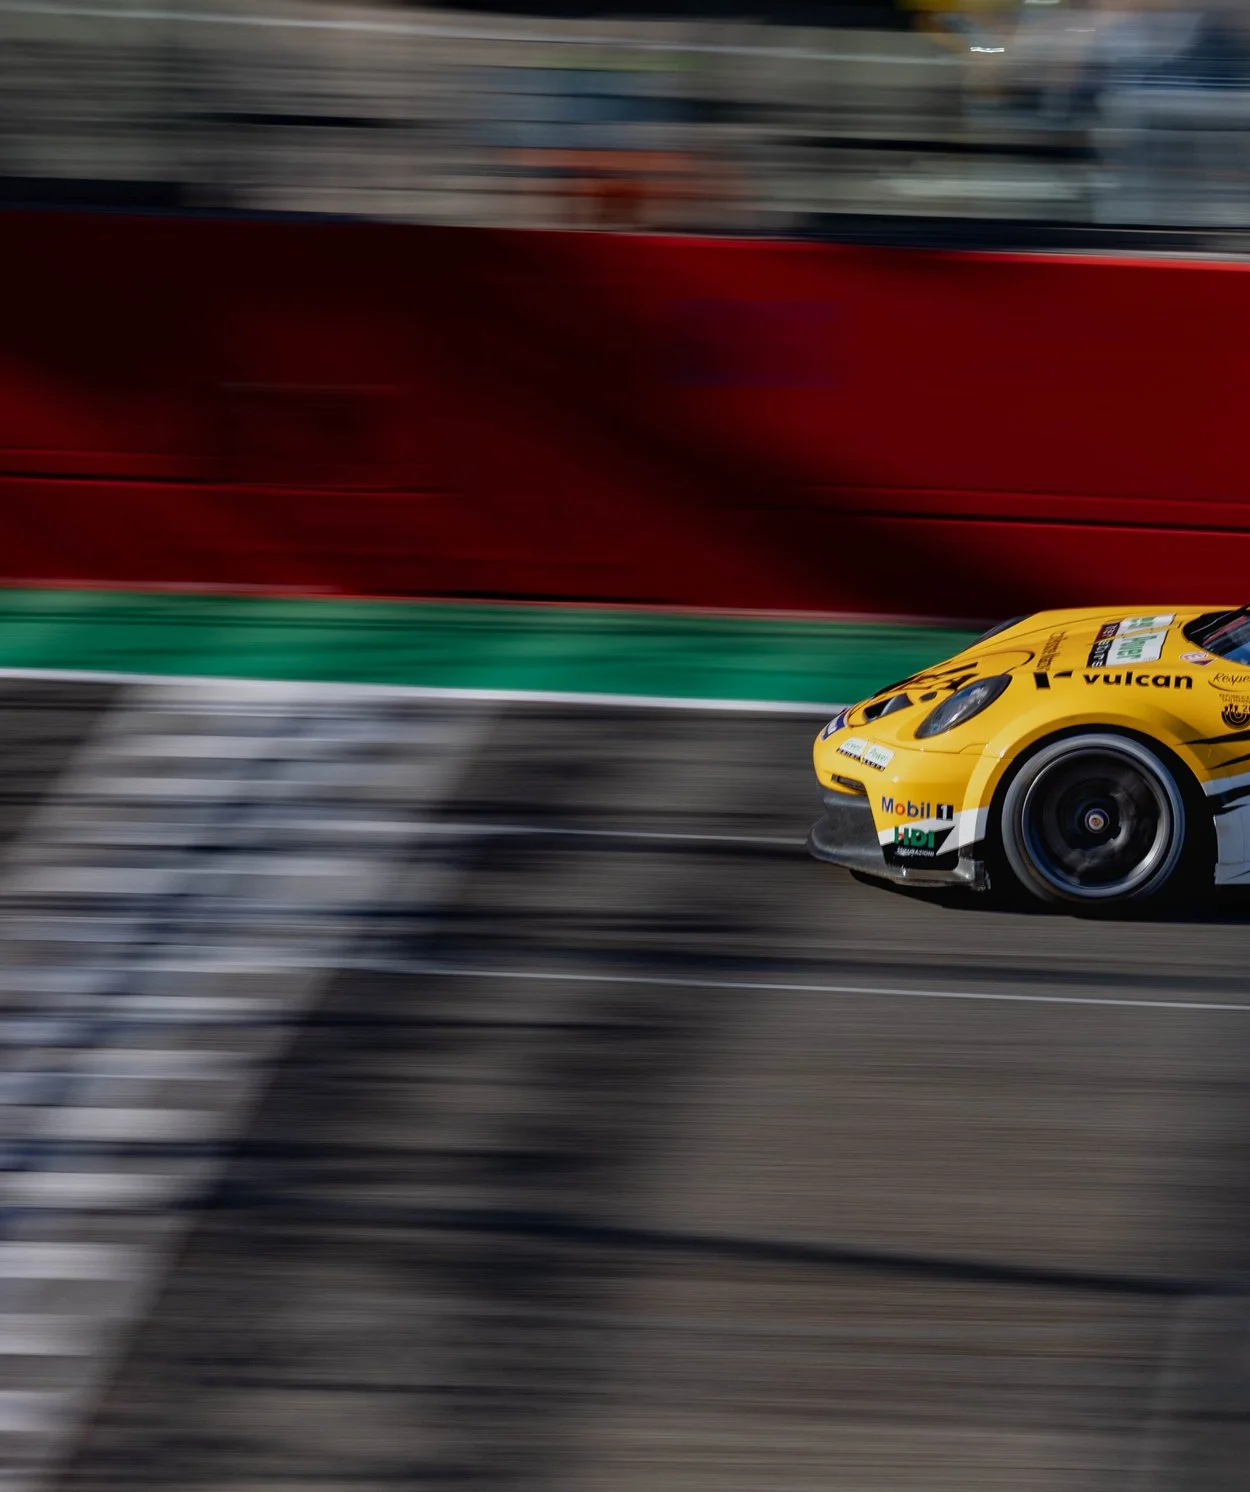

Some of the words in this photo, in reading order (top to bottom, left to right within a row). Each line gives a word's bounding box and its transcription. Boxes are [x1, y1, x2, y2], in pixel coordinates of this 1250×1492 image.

[1083, 671, 1193, 690] vulcan
[881, 796, 931, 818] Mobil
[893, 826, 935, 849] HDI
